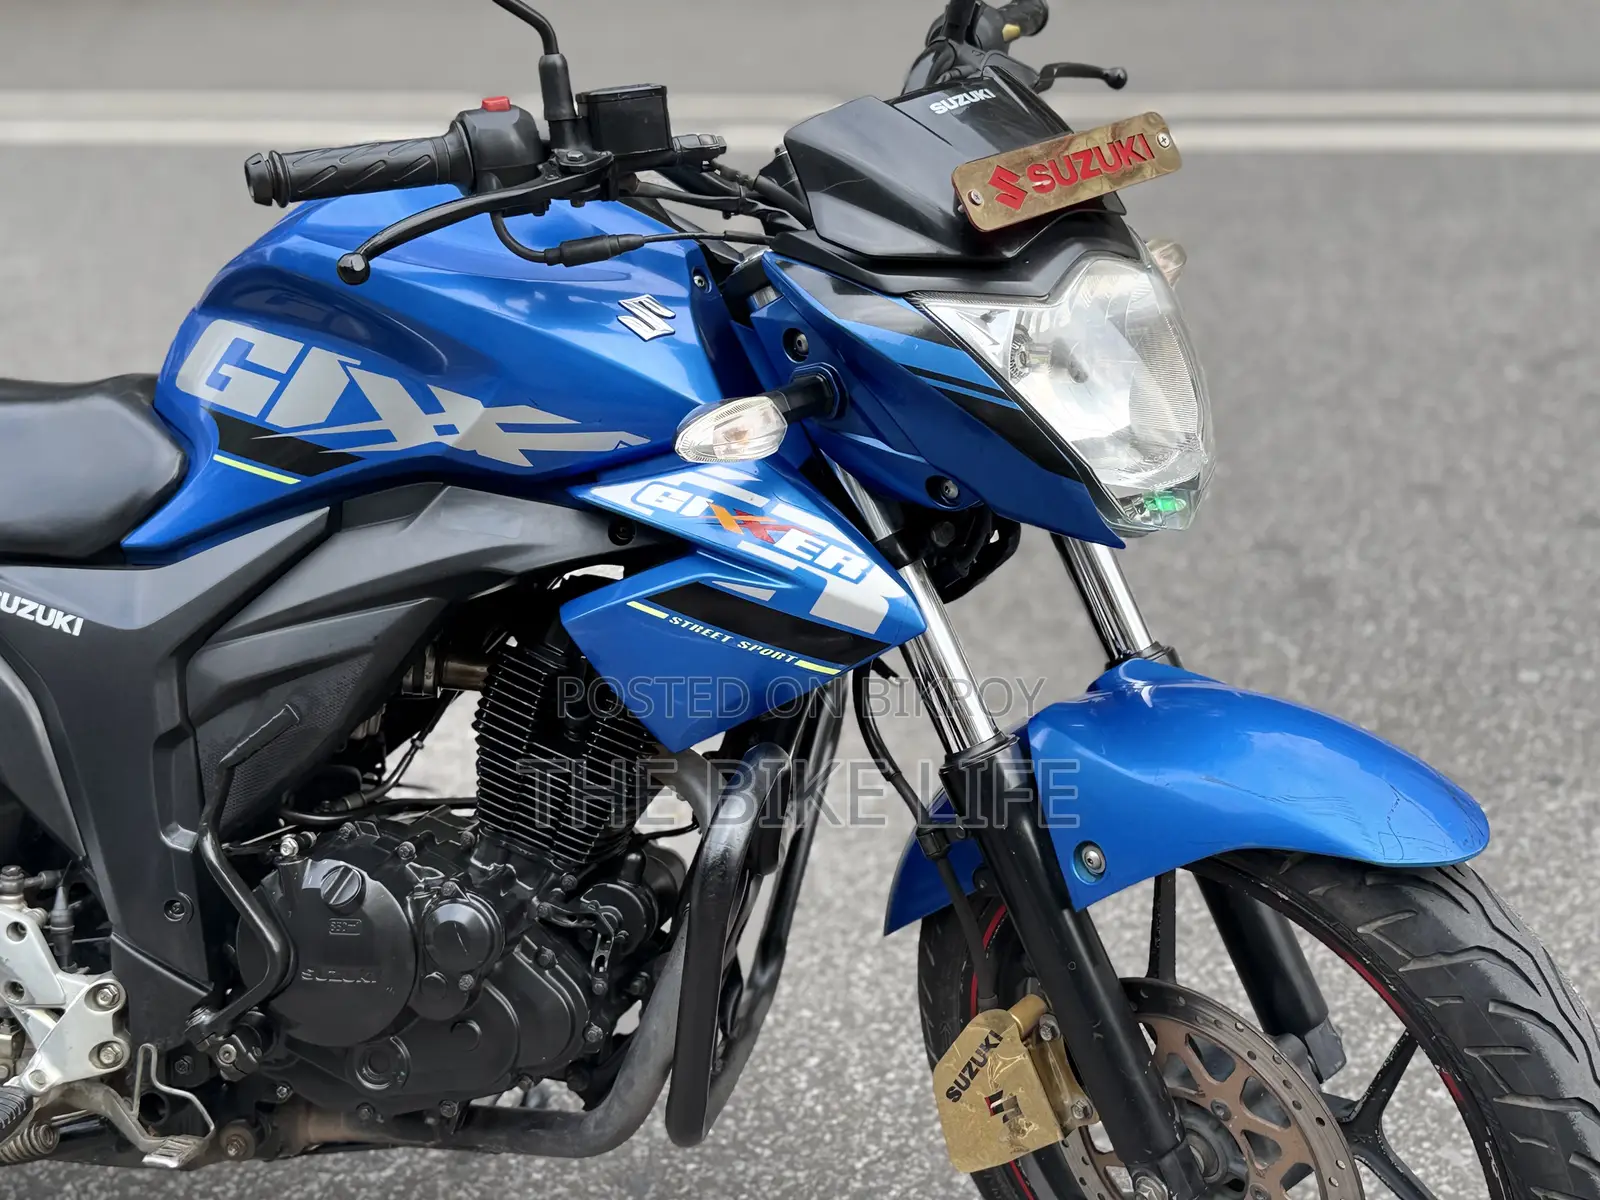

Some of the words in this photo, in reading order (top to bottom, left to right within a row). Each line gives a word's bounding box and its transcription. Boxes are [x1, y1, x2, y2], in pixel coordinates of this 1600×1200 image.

[929, 88, 996, 115] SUZUKI
[1026, 133, 1155, 194] SUZUKI
[634, 483, 870, 583] GIXXER
[0, 591, 84, 637] UZUKI
[668, 616, 734, 643] STREET
[737, 640, 798, 663] SPORT
[301, 968, 377, 984] SUZUKI
[945, 1029, 1004, 1103] SUZUKI
